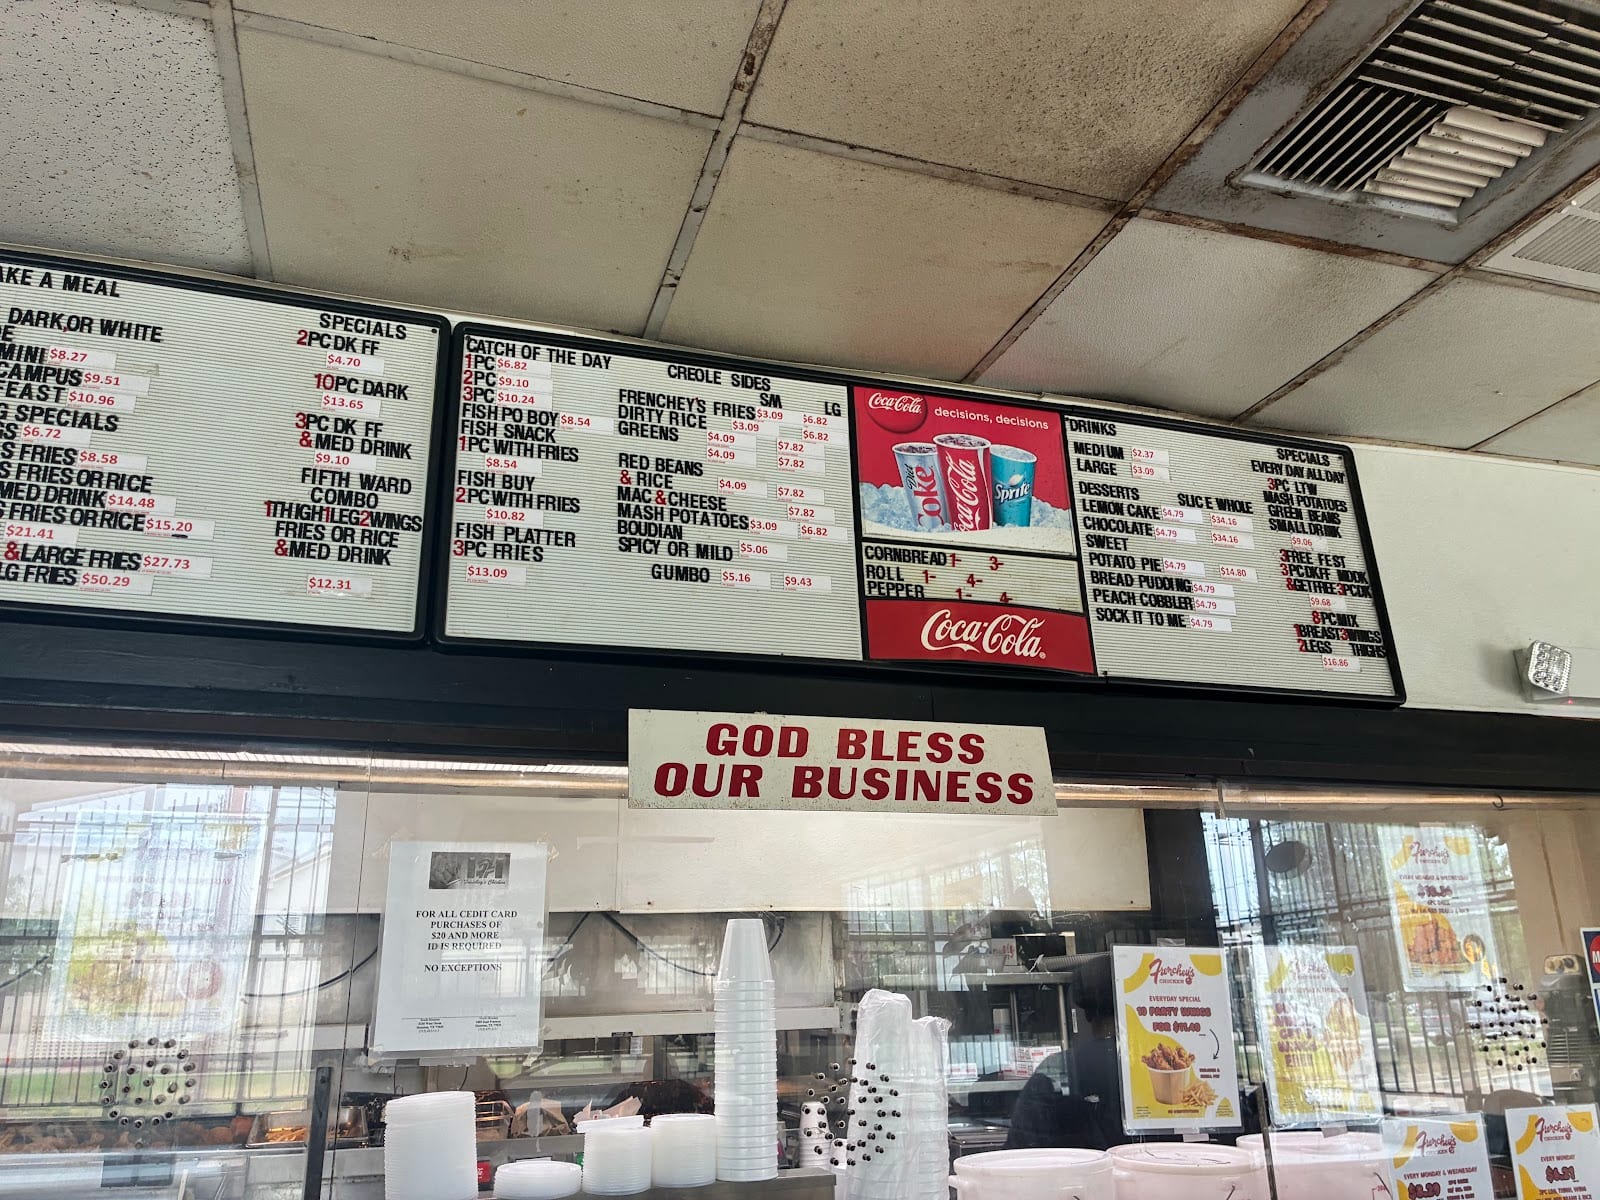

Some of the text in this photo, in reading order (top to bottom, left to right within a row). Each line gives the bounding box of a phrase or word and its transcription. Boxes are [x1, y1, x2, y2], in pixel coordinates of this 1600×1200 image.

[39, 272, 120, 297] A MEAL
[100, 319, 164, 343] WHITE
[319, 313, 407, 340] SPECIALS
[50, 348, 88, 362] $8.27
[362, 340, 380, 355] FF
[466, 338, 612, 370] CATCH OF THE DAY
[327, 354, 361, 367] $4.70
[497, 358, 527, 371] $6.82
[84, 372, 120, 386] $9.51
[498, 376, 529, 388] $9.10
[667, 364, 771, 391] CREOLE SIDES
[69, 391, 115, 406] $10.96
[363, 380, 409, 400] DARK
[497, 392, 535, 405] $10.24
[323, 395, 363, 410] $13.65
[619, 388, 756, 420] FRENCHEY'S FRIES
[760, 393, 841, 416] SM LG
[14, 405, 119, 432] SPECIALS
[462, 402, 559, 427] FISH PO BOY
[561, 414, 591, 427] $8.54
[618, 404, 707, 429] DIRTY RICE
[757, 409, 783, 420] $3.09
[803, 414, 828, 426] $6.82
[934, 407, 1049, 430] decisions, decisions
[22, 424, 61, 439] $6.72
[334, 418, 383, 437] DK FF
[461, 420, 556, 443] FISH SNACK
[618, 421, 679, 442] GREENS
[1069, 418, 1117, 436] DRINKS
[707, 432, 735, 444] $4.09
[778, 440, 804, 452] $7.82
[19, 444, 78, 465] FRIES
[79, 451, 118, 464] $8.58
[360, 438, 412, 460] DRINK
[494, 438, 579, 462] WITH FRIES
[1073, 441, 1124, 460] MEDIUM
[1132, 448, 1154, 459] $2.37
[1276, 448, 1331, 467] SPECIALS
[315, 453, 350, 465] $9.10
[618, 453, 704, 478] RED BEANS
[1076, 458, 1117, 475] LARGE
[15, 463, 154, 493] FRIES OR RICE
[1251, 460, 1305, 479] EVERY DAY
[301, 467, 412, 494] FIFTH WARD
[458, 470, 535, 492] FISH BUY
[637, 472, 673, 490] RICE
[44, 484, 108, 508] DRINK
[310, 487, 379, 509] COMBO
[617, 485, 652, 504] MAC
[994, 482, 1030, 505] Sprite
[1078, 481, 1140, 500] DESSERTS
[108, 494, 155, 508] $14.48
[537, 494, 580, 513] FRIES
[1082, 499, 1161, 520] LEMON CAKE
[1177, 493, 1254, 514] SLICE WHOLE
[486, 508, 525, 521] $10.82
[617, 503, 749, 530] MASH POTATOES
[6, 524, 54, 540] $21.41
[146, 518, 192, 532] $15.20
[275, 520, 400, 548] FRIES OR RICE
[617, 520, 683, 540] BOUDIAN
[1083, 516, 1153, 536] CHOCOLATE
[455, 522, 576, 548] FISH PLATTER
[1086, 534, 1128, 551] SWEET
[338, 545, 391, 566] DRINK
[493, 543, 544, 562] FRIES
[618, 537, 733, 561] SPICY OR MILD
[740, 543, 768, 555] $5.06
[864, 545, 947, 566] CORNBREAD
[89, 550, 142, 571] FRIES
[143, 556, 190, 570] $27.73
[1089, 551, 1162, 572] POTATO PIE
[23, 565, 77, 586] FRIES
[82, 572, 130, 587] $50.29
[467, 565, 508, 578] $13.09
[652, 564, 710, 583] GUMBO
[722, 571, 751, 583] $5.16
[866, 564, 905, 581] ROLL
[1220, 566, 1247, 577] $14.80
[309, 577, 351, 590] $12.31
[784, 576, 812, 587] $9.43
[867, 581, 924, 598] PEPPER
[1090, 570, 1193, 593] BREAD PUDDING
[1093, 588, 1194, 610] PEACH COBBLER
[1096, 607, 1187, 628] SOCK IT TO ME
[1190, 617, 1213, 628] $4.79
[705, 722, 986, 765] GOD BLESS
[653, 762, 1034, 805] OUR BUSINESS
[416, 910, 518, 918] FOR ALL CEDIT CARD
[430, 920, 502, 929] PURCHASES OF
[431, 931, 500, 940] $20 AND MORE
[427, 942, 502, 951] ID IS REQUIRED
[424, 963, 502, 972] NO EXCEPTIONS
